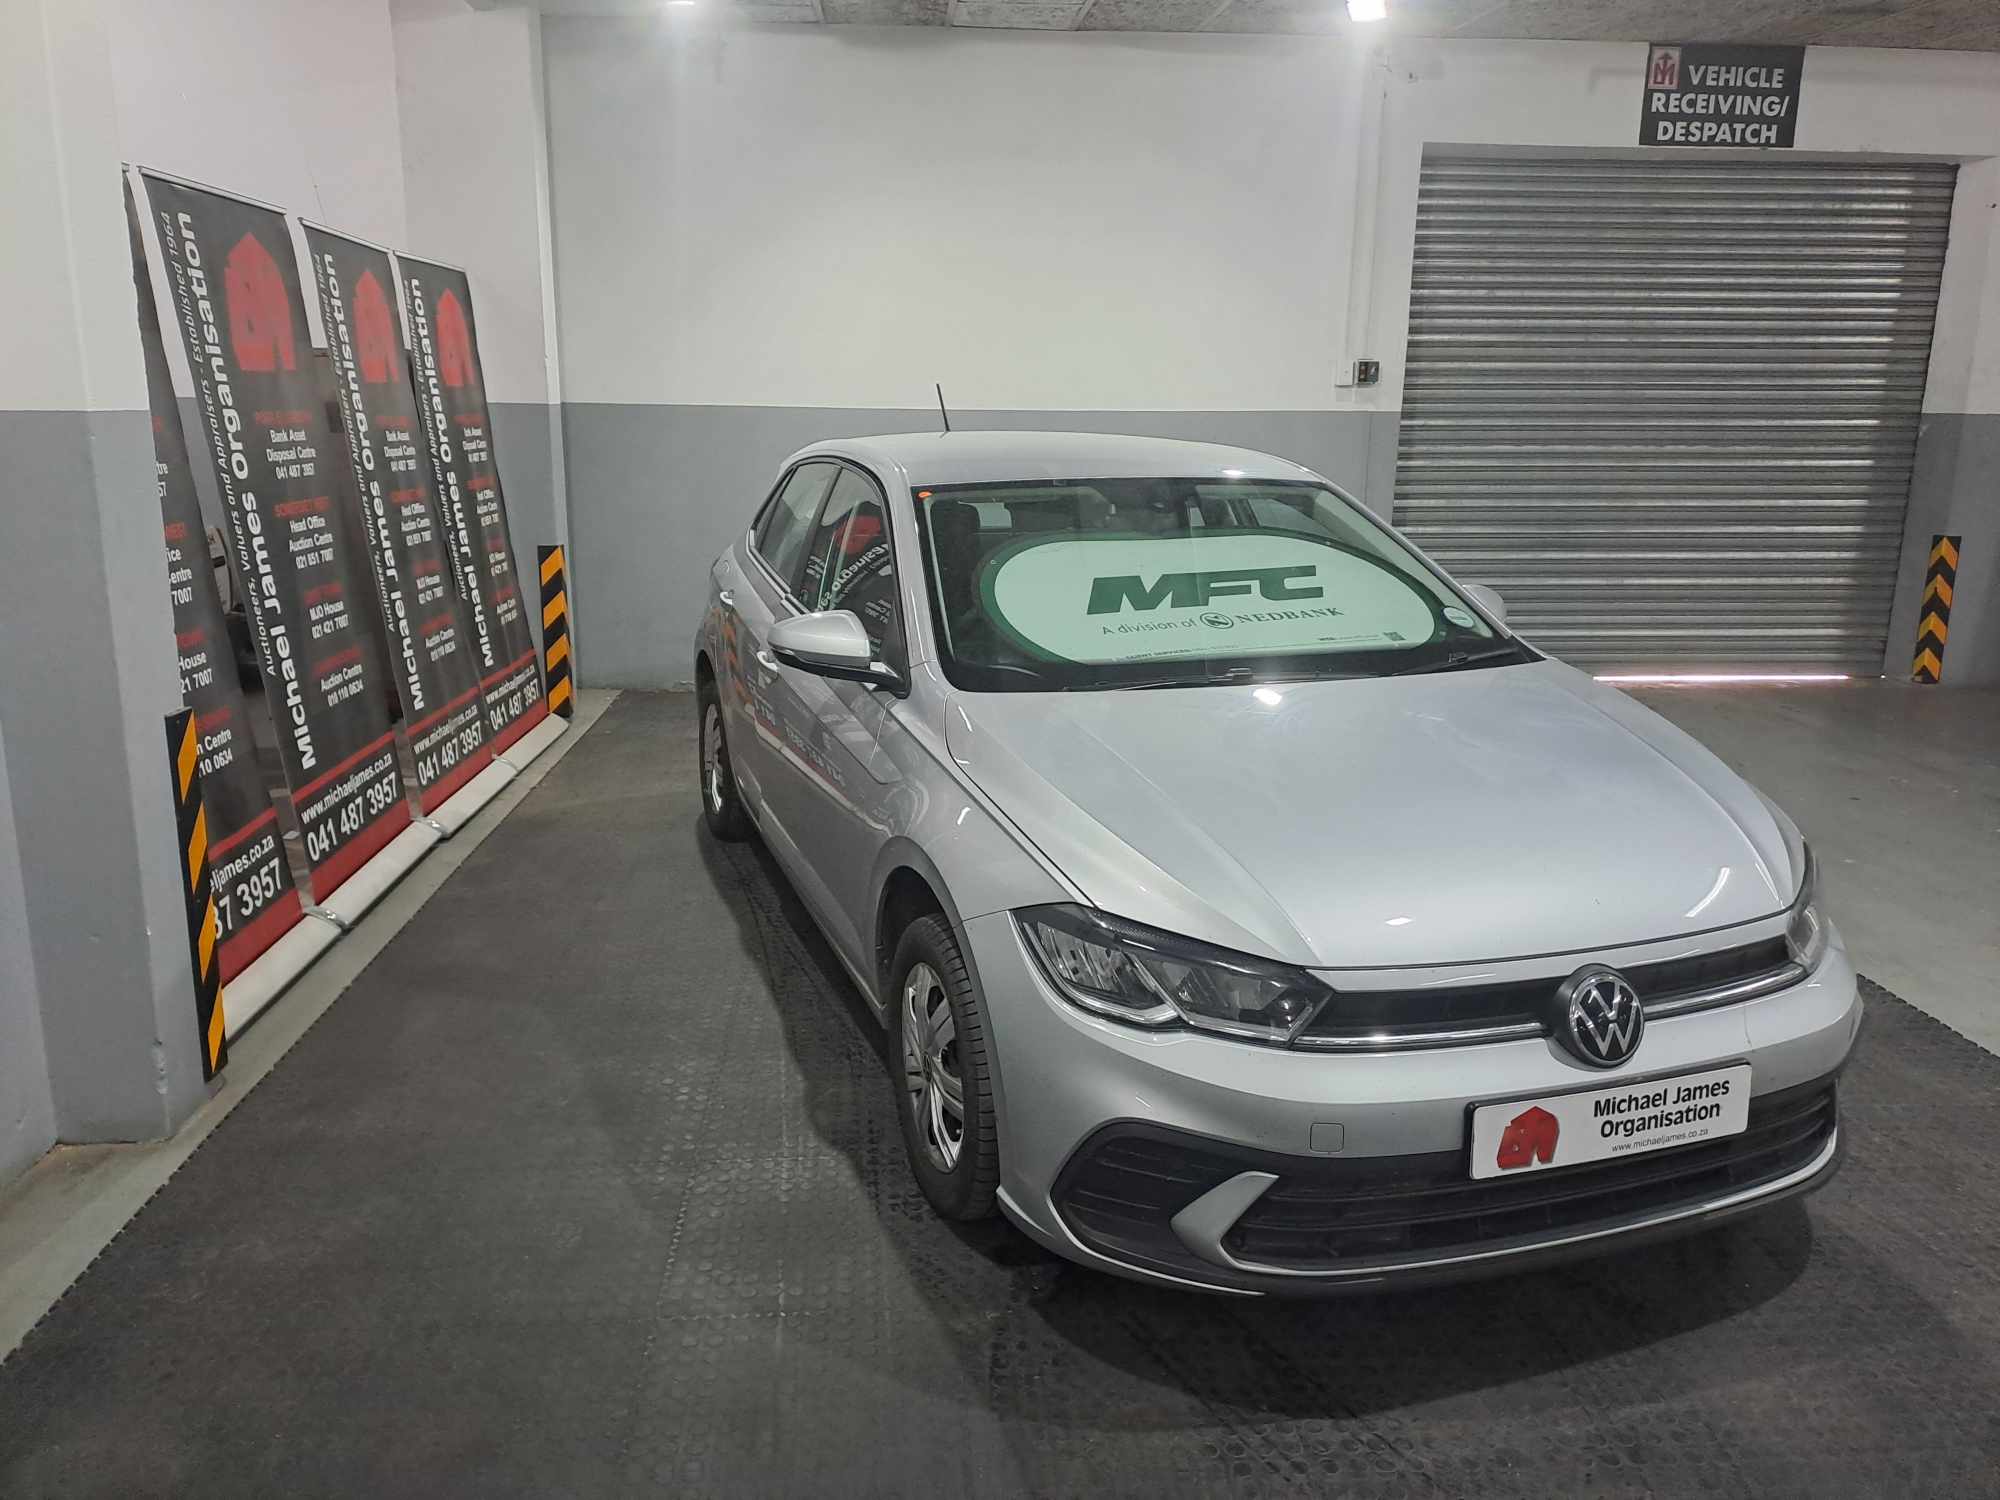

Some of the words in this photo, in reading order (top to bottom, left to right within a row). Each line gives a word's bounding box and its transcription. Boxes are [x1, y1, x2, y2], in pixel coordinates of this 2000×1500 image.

[1651, 92, 1790, 117] RECEIVING/
[1688, 65, 1785, 89] VEHICLE
[1656, 120, 1778, 144] DESPATCH
[161, 211, 179, 256] 1964
[172, 261, 203, 364] Established
[177, 212, 249, 480] Organisation
[323, 253, 375, 471] Organisation
[411, 278, 452, 463] Organisation
[201, 379, 227, 469] Appraisers
[220, 472, 236, 505] and
[446, 471, 472, 558] James
[231, 511, 251, 571] Valuers
[242, 491, 282, 615] James
[369, 480, 399, 583] James
[169, 567, 192, 584] entre
[1086, 565, 1324, 615] MFC
[463, 564, 495, 668] Michael
[1101, 625, 1113, 636] A
[1118, 619, 1178, 634] division
[1181, 617, 1198, 630] of
[1236, 606, 1345, 624] NEDBANK
[390, 590, 425, 711] Michael
[270, 625, 317, 770] Michael
[489, 703, 509, 731] 041
[508, 692, 524, 718] 487
[204, 728, 232, 751] Centre
[418, 751, 441, 786] 041
[441, 737, 461, 769] 487
[460, 720, 483, 755] 3957
[307, 817, 338, 862] 041
[340, 796, 365, 835] 487
[366, 771, 398, 815] 3957
[209, 834, 275, 893] eljames.co.za
[237, 857, 283, 917] 3957
[1593, 1088, 1668, 1118] Michael
[1672, 1079, 1730, 1105] James
[1599, 1101, 1721, 1139] Organisation
[1611, 1128, 1709, 1152] www.michaeljames.co.za
